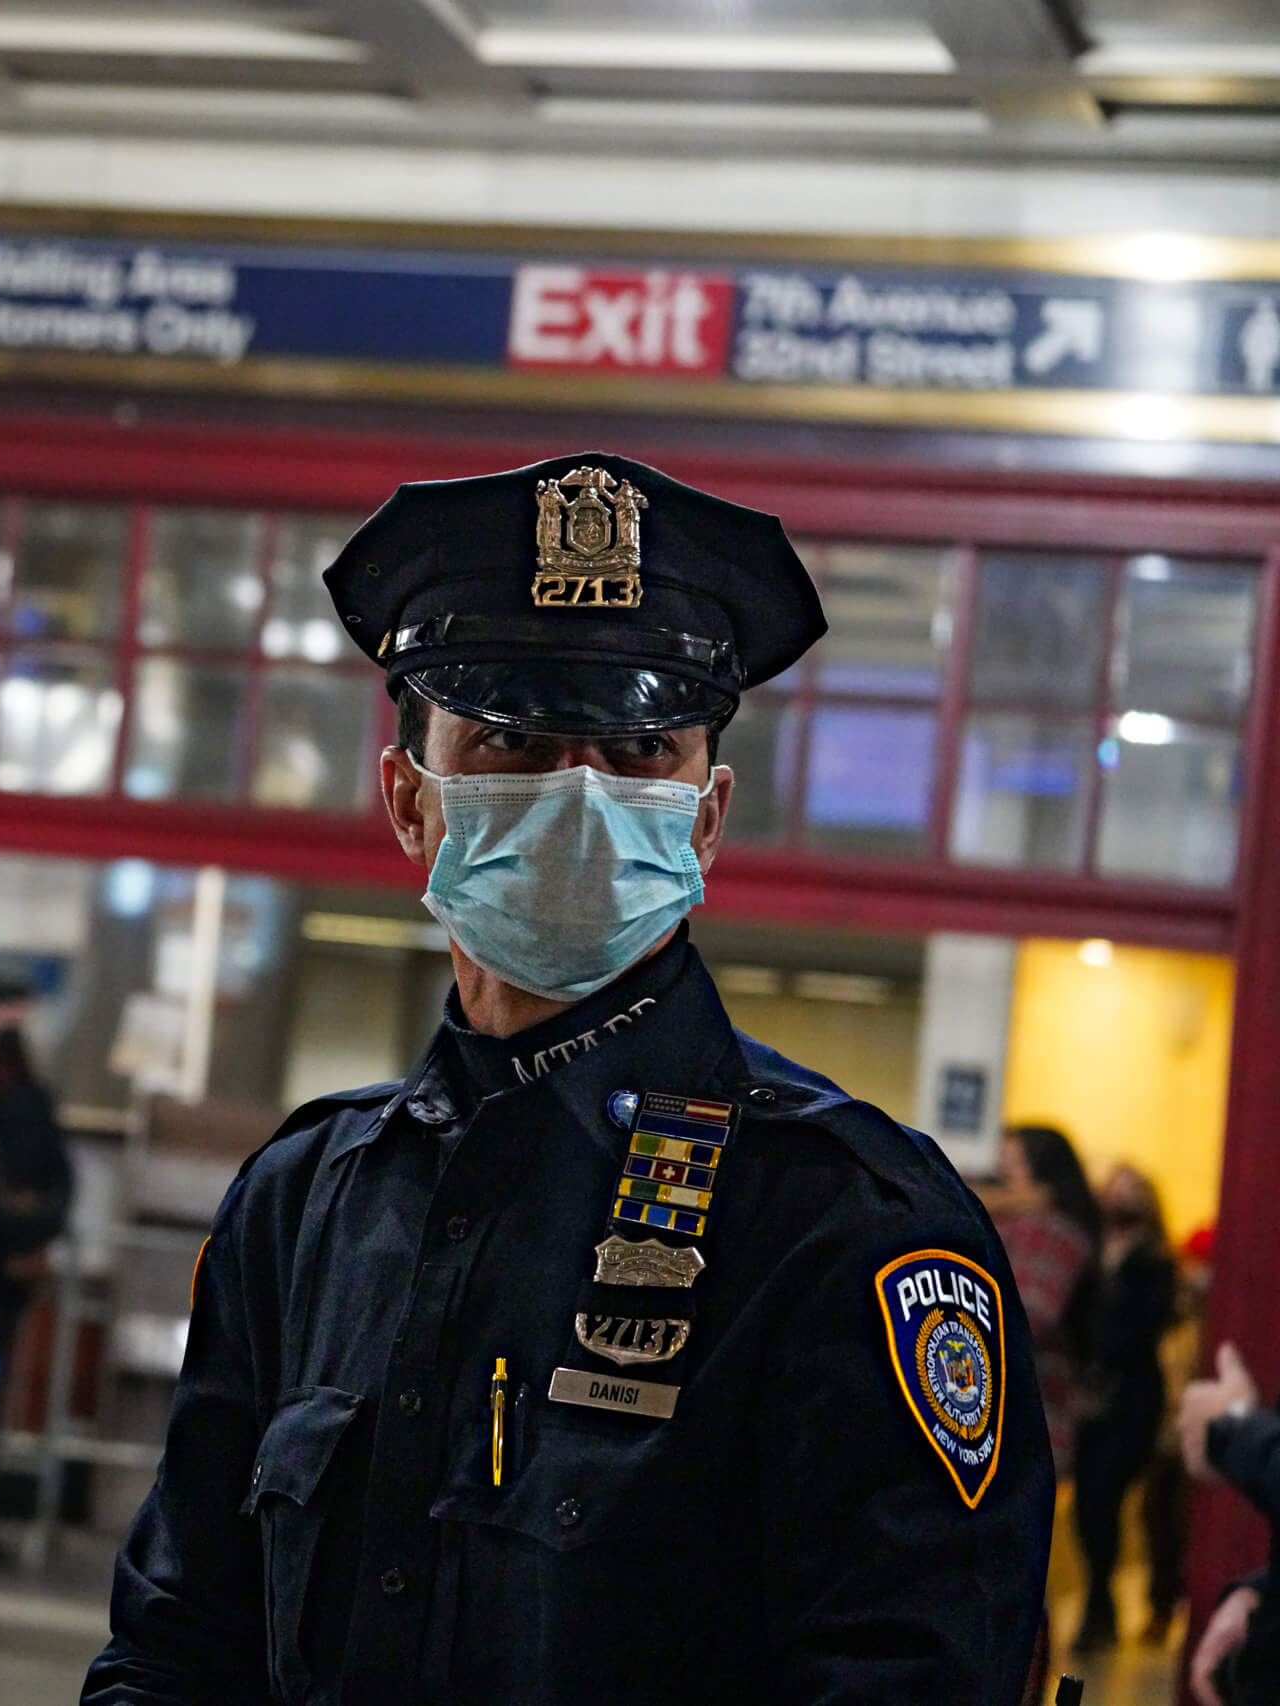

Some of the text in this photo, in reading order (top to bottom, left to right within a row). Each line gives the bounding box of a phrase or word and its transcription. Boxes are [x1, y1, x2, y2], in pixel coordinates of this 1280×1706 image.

[129, 249, 236, 303] Area
[510, 264, 707, 369] Exit
[744, 273, 1017, 336] 7th Avenue
[142, 303, 256, 366] Only
[734, 329, 1013, 388] 32nd Street
[541, 577, 636, 606] 2713
[896, 1269, 992, 1332] POLICE
[588, 1314, 666, 1354] 2713
[926, 1320, 988, 1409] METROPOLITAN TRANSPORTATION
[589, 1382, 640, 1405] DANISI
[943, 1401, 982, 1426] AUTHORITY
[932, 1423, 995, 1466] NEW YORK STATE
